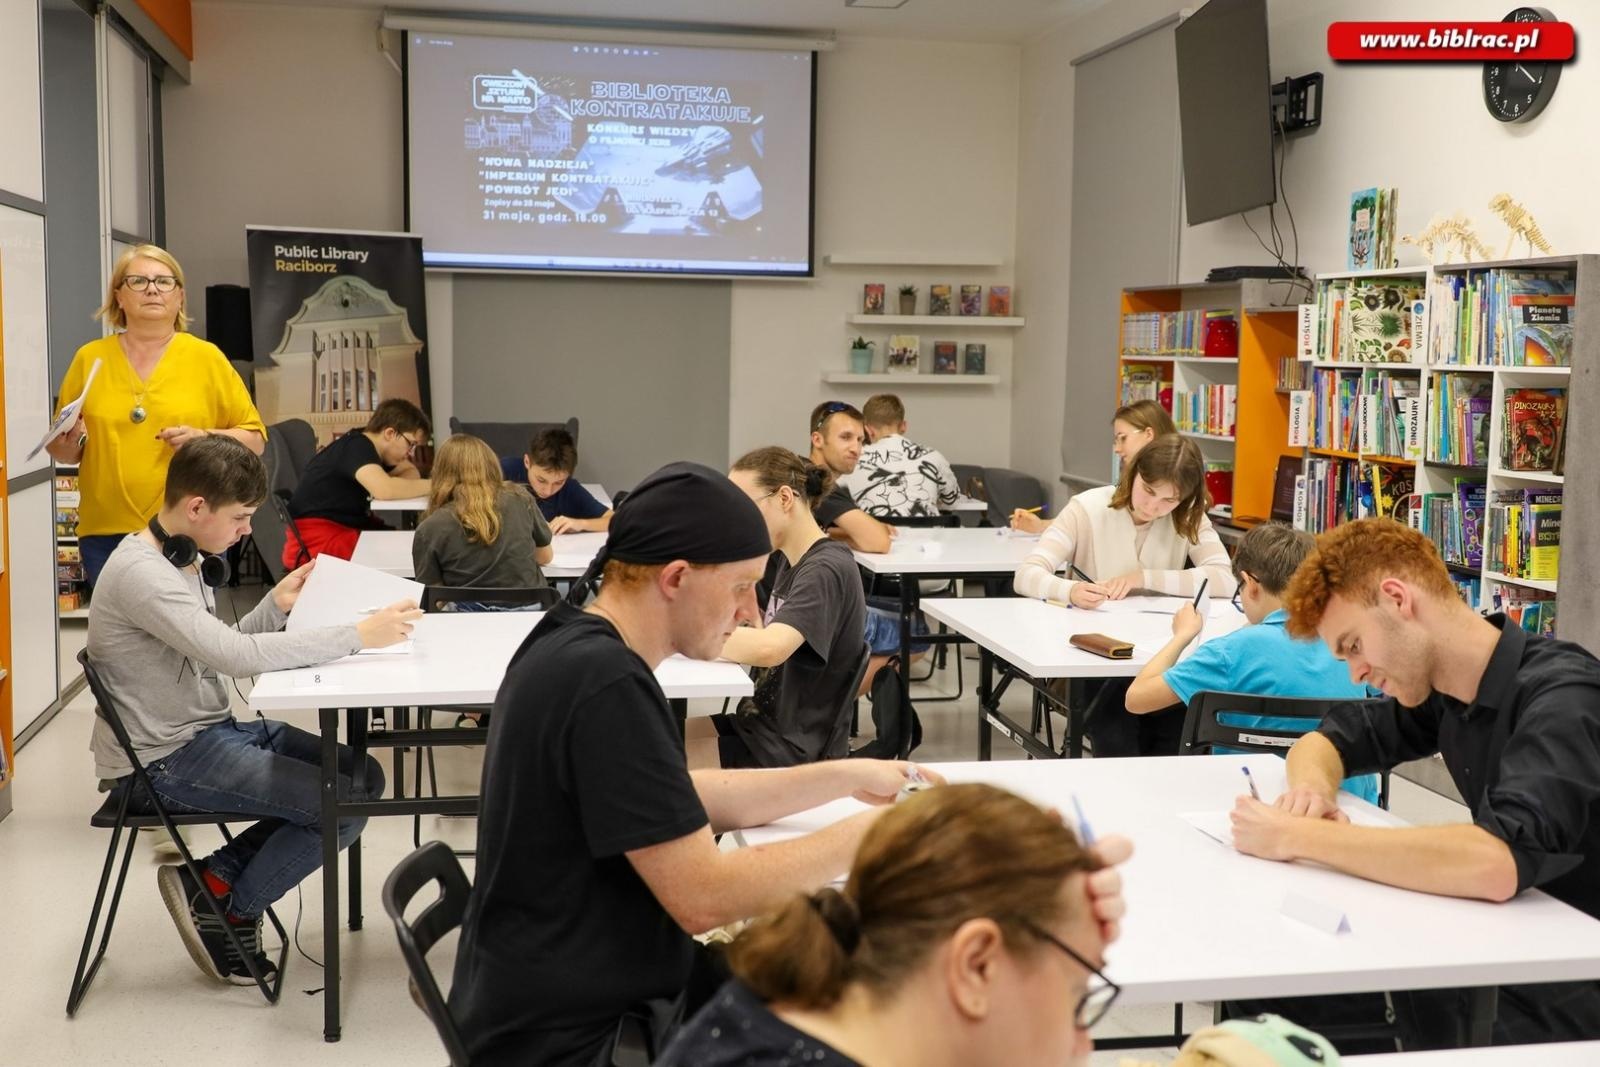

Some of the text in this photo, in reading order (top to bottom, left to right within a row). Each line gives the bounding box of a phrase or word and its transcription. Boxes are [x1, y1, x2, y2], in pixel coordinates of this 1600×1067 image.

[591, 81, 731, 103] BIBLIOTEKA
[1503, 100, 1508, 109] 7
[1527, 94, 1532, 104] 5
[569, 99, 752, 124] KONTRATAKUJE
[1514, 104, 1519, 113] 6
[586, 123, 698, 137] KONKURS WIEDZY
[479, 157, 522, 168] "NOWA
[479, 171, 546, 182] "IMPERIUM
[479, 183, 540, 195] "POWRÓT
[483, 210, 495, 220] 31
[274, 245, 369, 263] Public Library
[275, 260, 337, 273] Raciborz
[1303, 307, 1311, 346] ROŚLINY
[1414, 315, 1423, 350] ZIEMIA
[1514, 402, 1555, 411] DINOZAURY
[1411, 400, 1419, 446] DINOZAURY
[314, 675, 321, 683] 8
